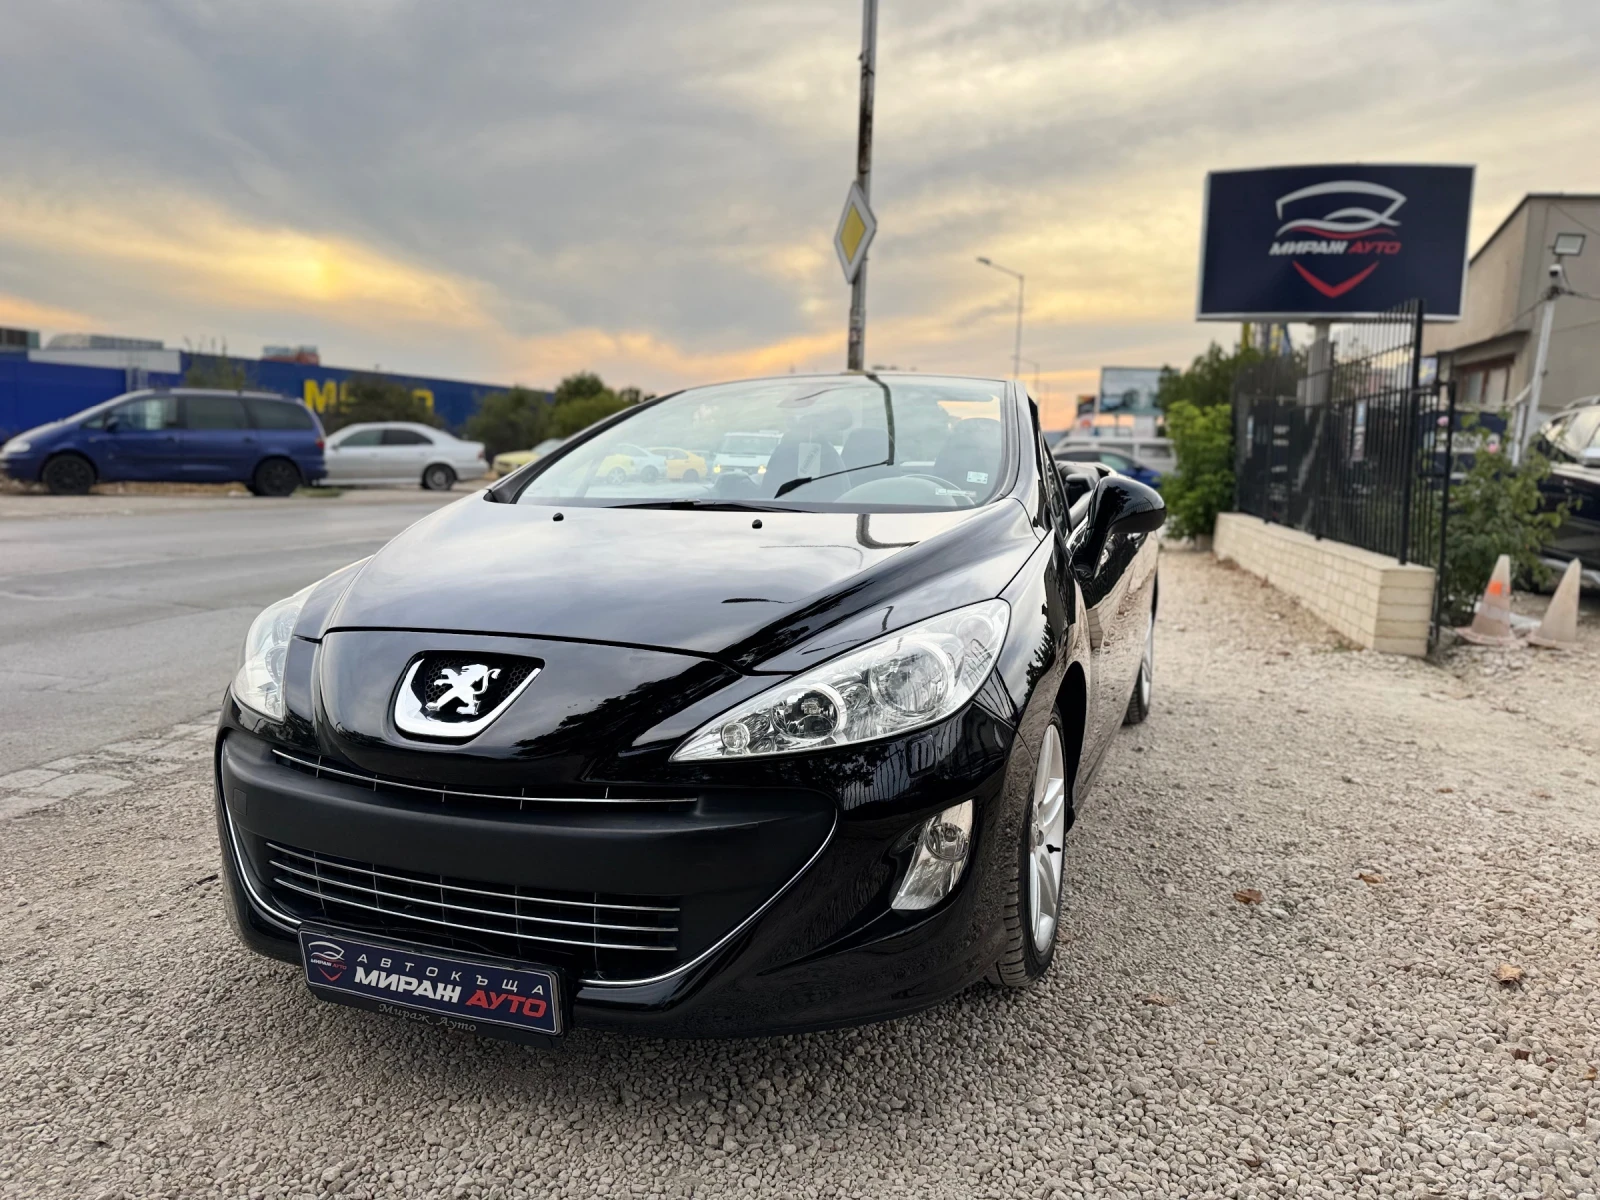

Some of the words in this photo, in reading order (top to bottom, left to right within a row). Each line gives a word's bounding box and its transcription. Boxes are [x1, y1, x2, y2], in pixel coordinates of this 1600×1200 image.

[1269, 240, 1347, 256] МИРАЖ
[1348, 241, 1402, 255] АУТО
[354, 966, 462, 1004] МИРАЖ
[465, 990, 547, 1018] АУТО
[357, 953, 544, 996] АВТОКЪЩА
[378, 1003, 434, 1026] Мираж
[436, 1017, 477, 1032] Ауто
